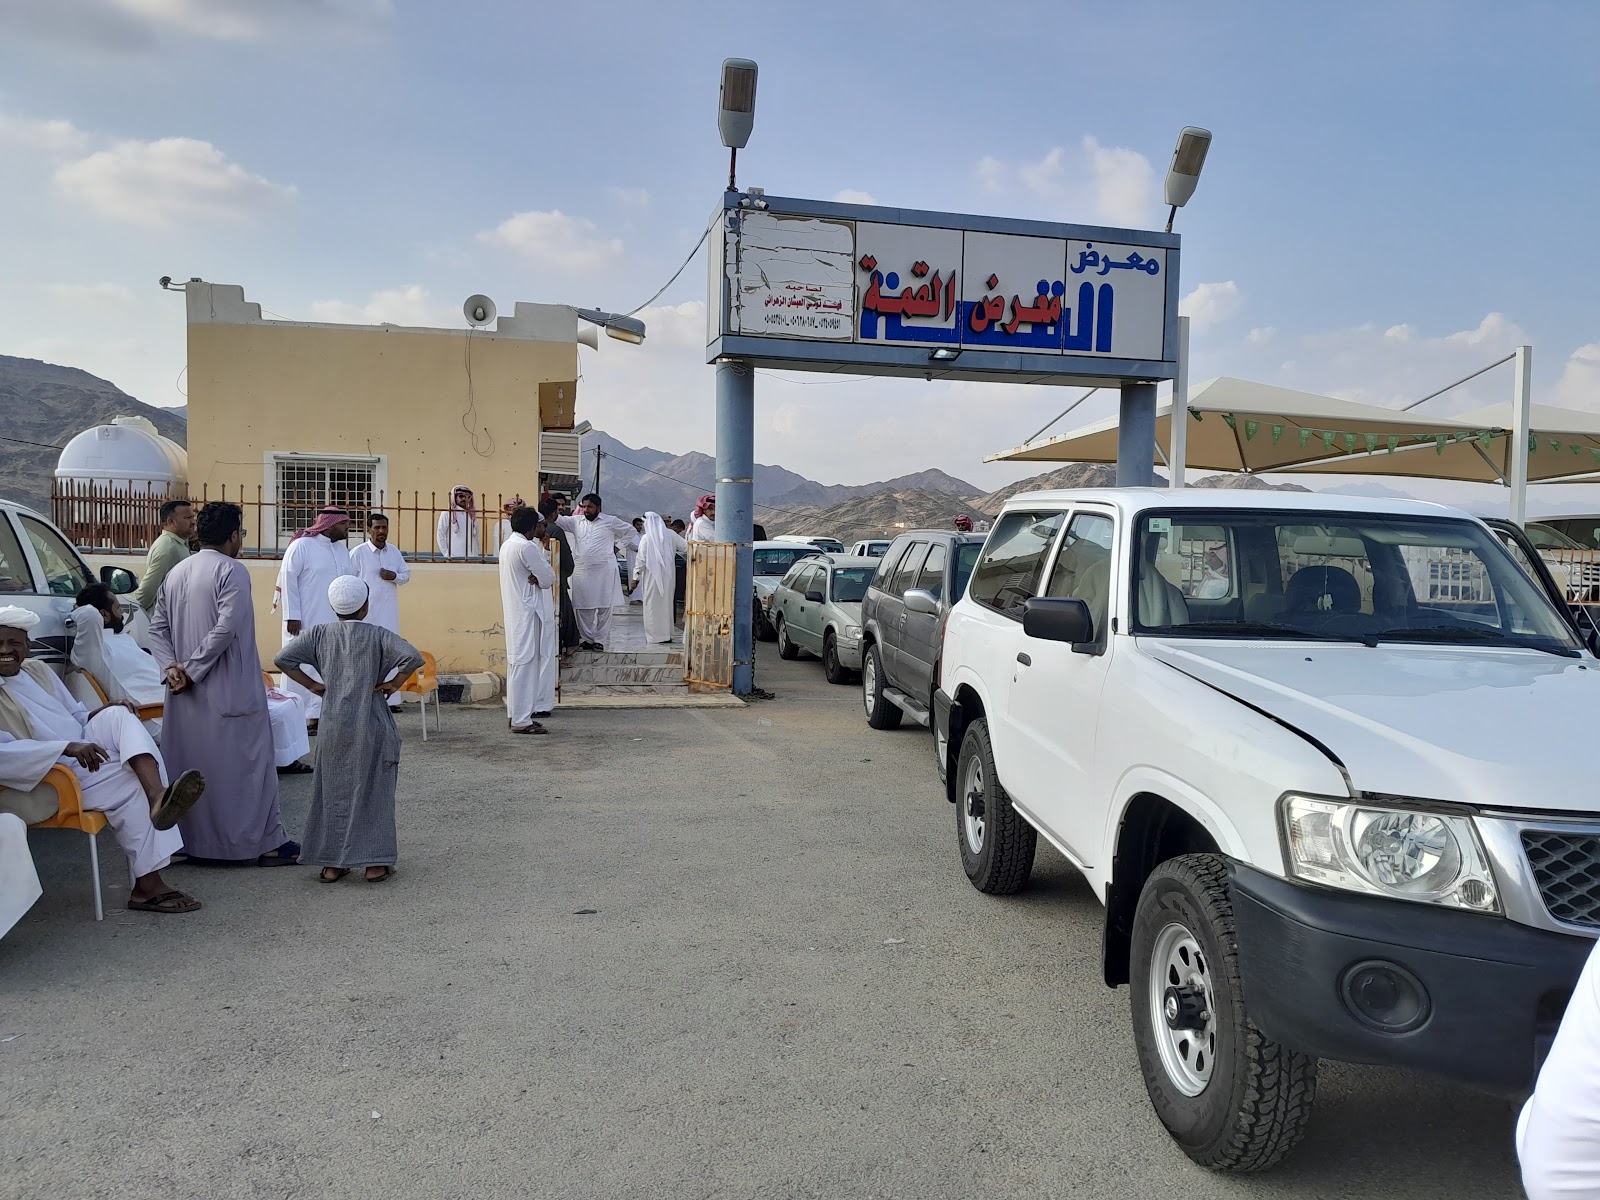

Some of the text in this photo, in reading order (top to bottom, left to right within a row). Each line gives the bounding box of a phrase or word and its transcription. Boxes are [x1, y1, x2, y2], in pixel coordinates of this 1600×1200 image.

[1070, 242, 1160, 275] معرض
[858, 253, 1063, 336] معرض القمة
